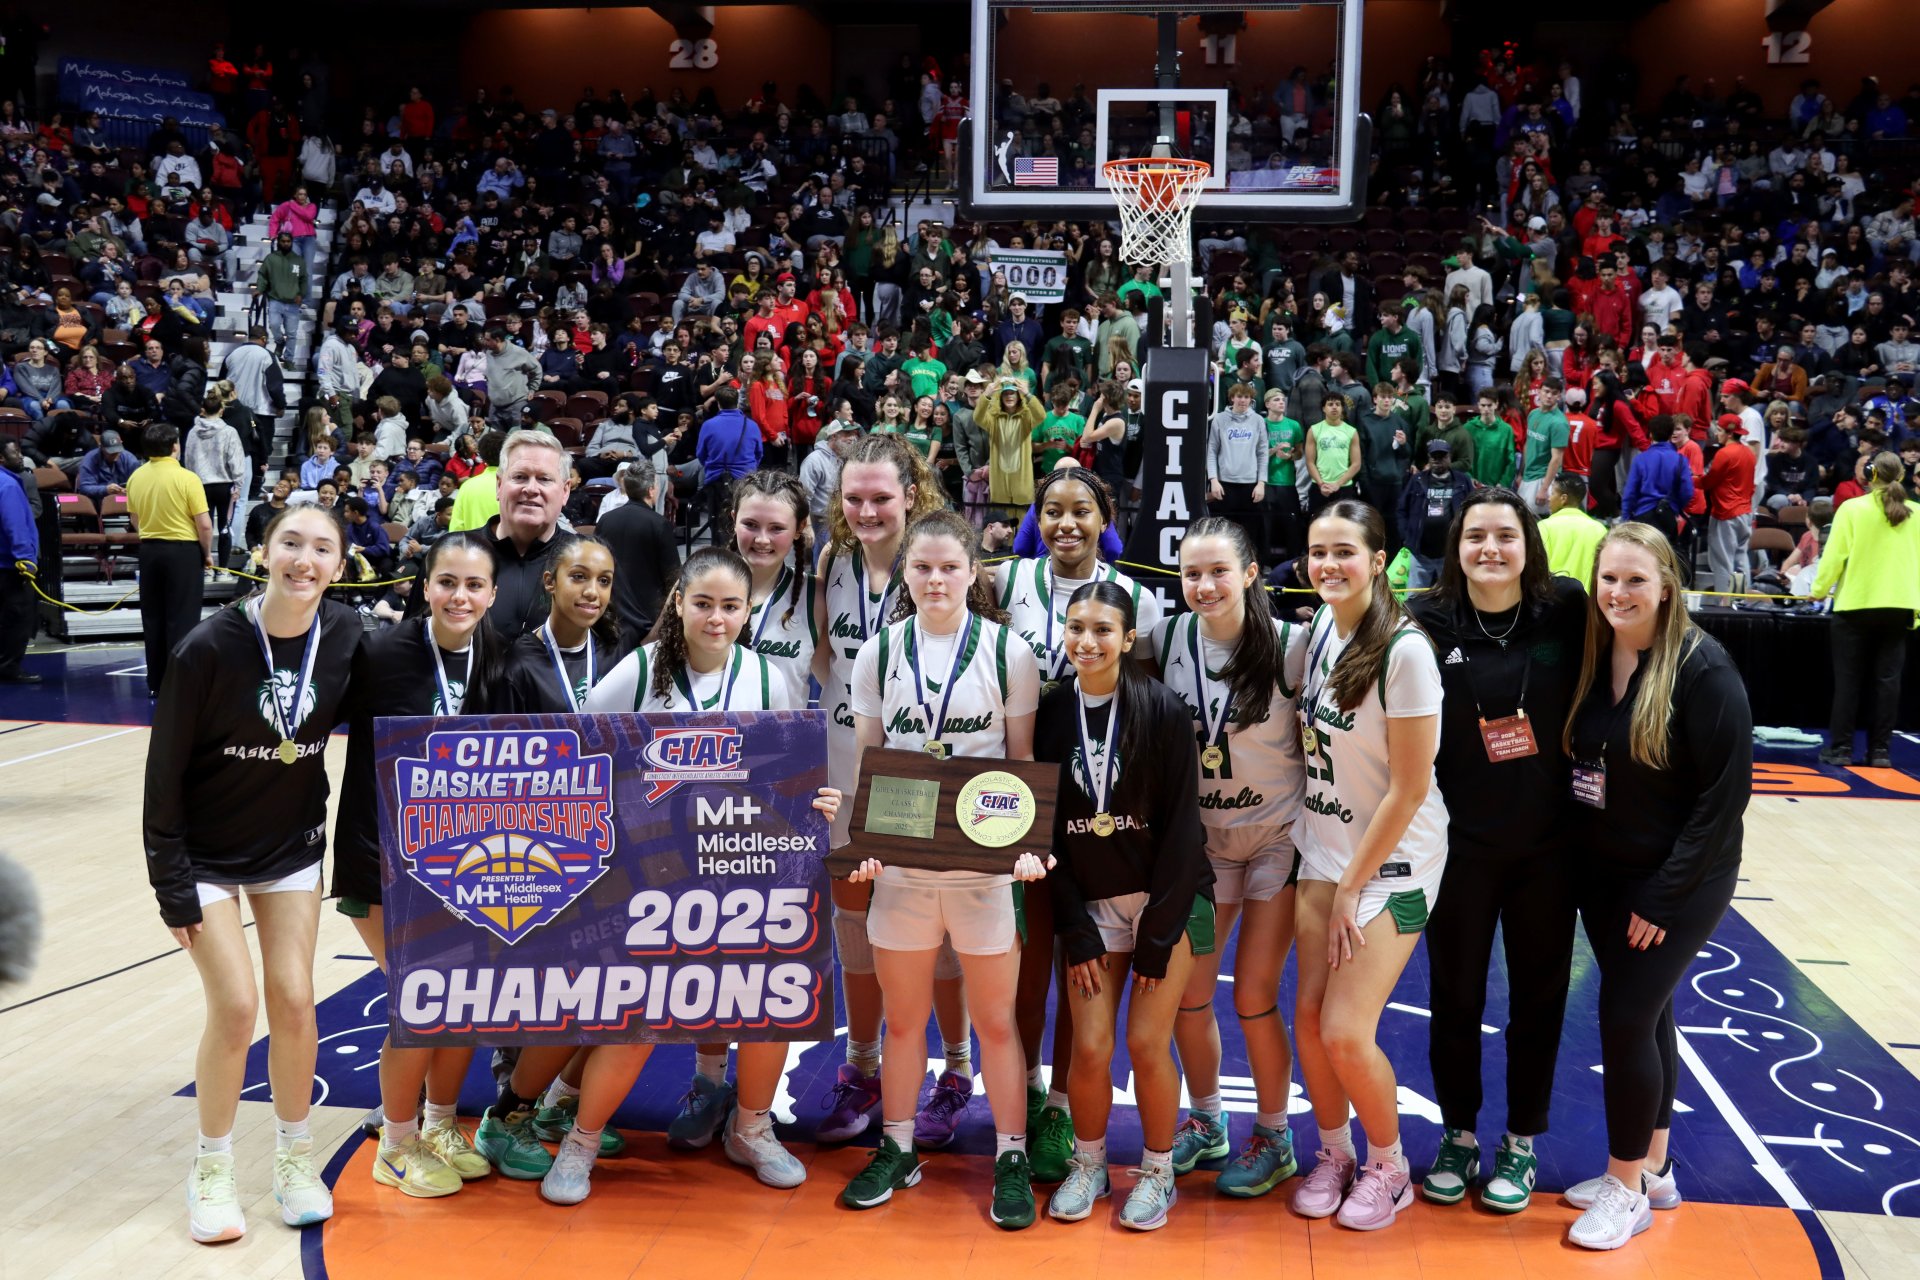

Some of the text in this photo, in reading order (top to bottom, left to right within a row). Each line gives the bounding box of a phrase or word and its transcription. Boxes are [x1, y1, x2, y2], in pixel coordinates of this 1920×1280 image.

[669, 39, 718, 69] 28
[1200, 34, 1236, 64] 11
[1762, 31, 1812, 64] 12
[64, 63, 187, 87] Mohegan Sun Arena
[86, 85, 210, 110] Mohegan Sun Arena
[1291, 166, 1315, 174] BIG
[1267, 349, 1291, 358] NWC
[1382, 344, 1407, 354] LIONS
[1227, 428, 1252, 440] Valley
[1569, 420, 1584, 444] 7
[1155, 389, 1190, 566] CIAC
[886, 705, 993, 734] Norwest
[223, 736, 325, 761] BASKEBALL
[455, 736, 549, 768] CIAC
[660, 734, 744, 767] CIAC
[1491, 736, 1530, 749] BASKETBALL
[1511, 745, 1529, 753] COACH
[410, 762, 606, 799] BASKETBALL
[981, 795, 1020, 810] CIAC
[1198, 786, 1263, 811] atholic
[404, 802, 610, 856] CHAMPIONSHIPS
[697, 832, 817, 853] Middlesex
[698, 854, 776, 875] Health
[481, 874, 537, 883] PRESENTED BY
[503, 883, 562, 893] Middlesex
[503, 894, 543, 904] Health
[625, 887, 813, 948] 2025
[400, 963, 814, 1026] CHAMPIONS
